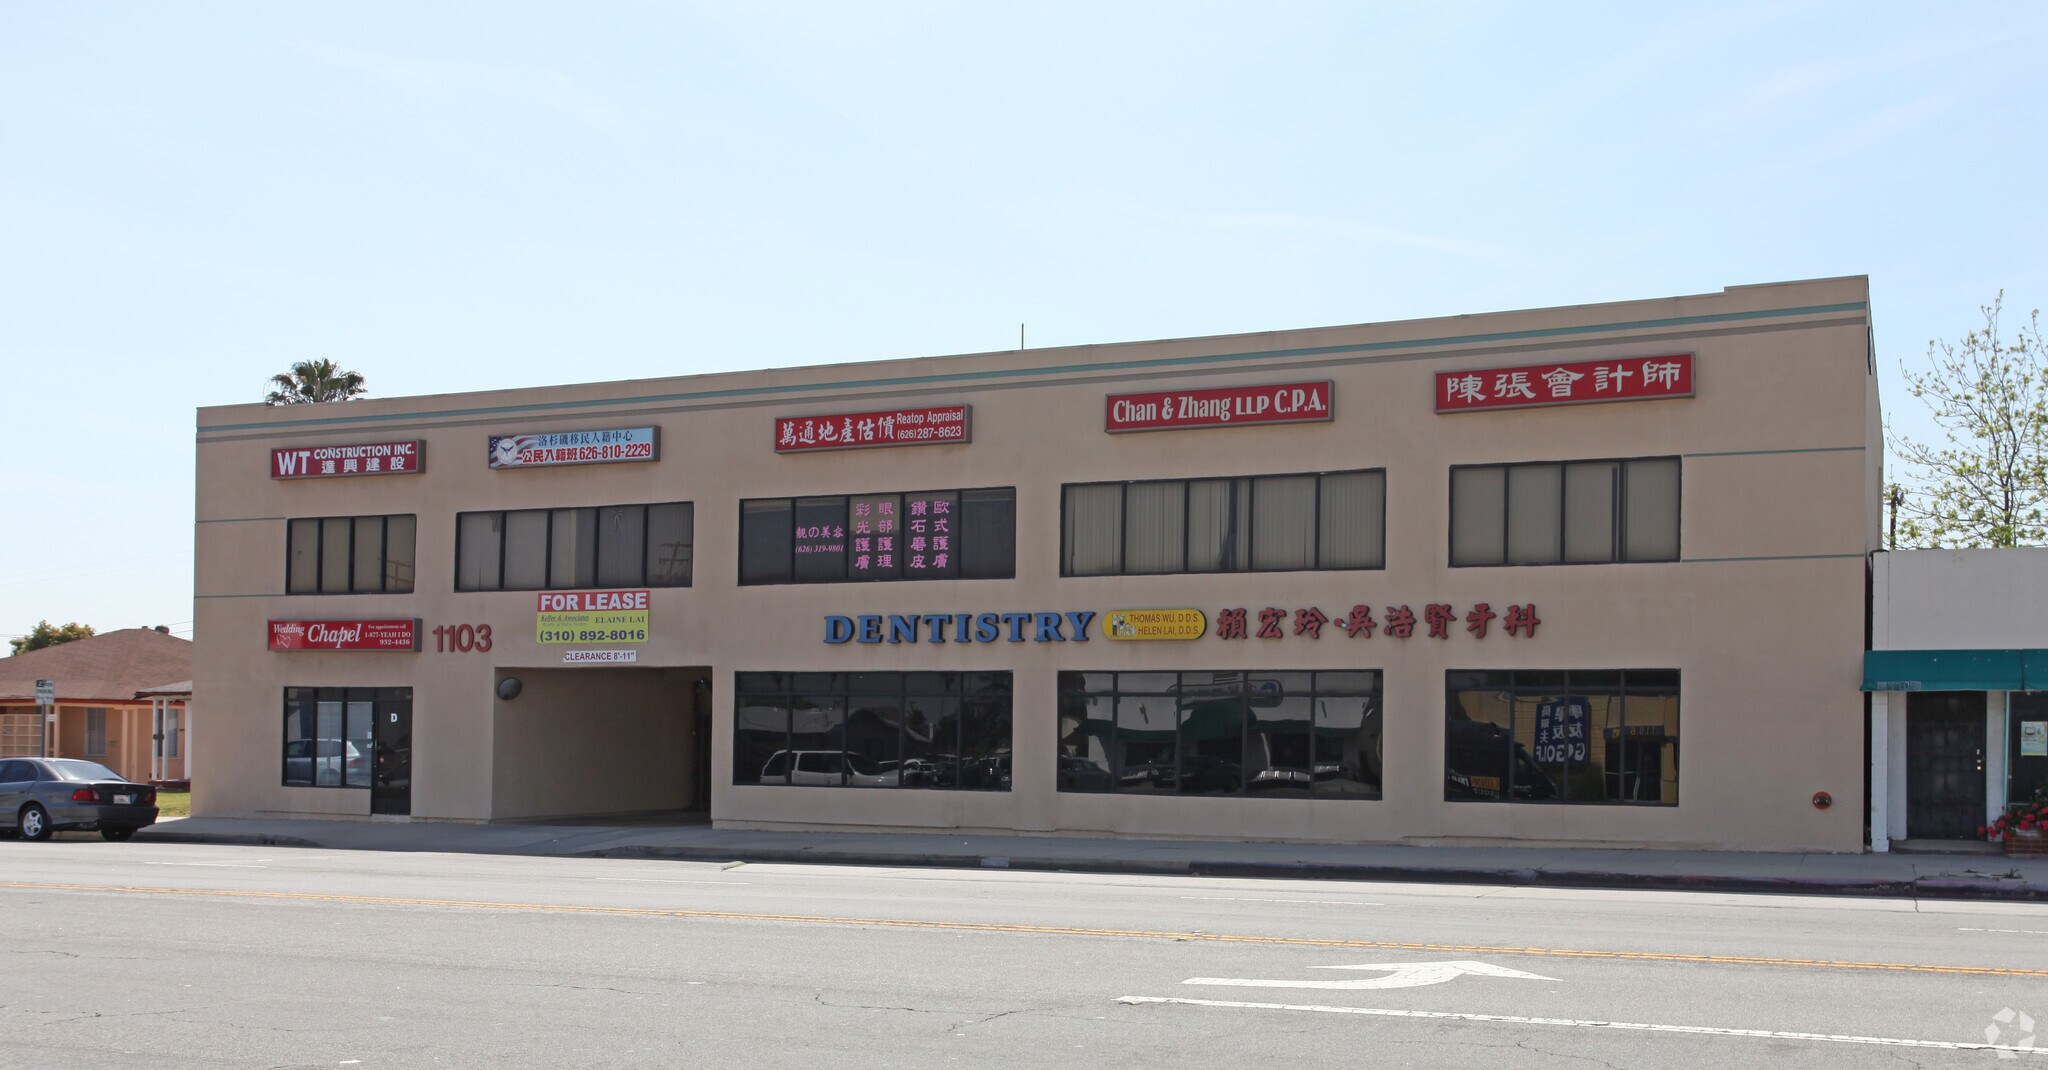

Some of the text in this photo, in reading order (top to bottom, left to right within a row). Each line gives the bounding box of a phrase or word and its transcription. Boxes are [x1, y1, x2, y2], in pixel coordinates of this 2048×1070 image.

[1447, 361, 1682, 403] 陳張會計師
[1113, 388, 1326, 423] Chan & Zhang LLP C.P.A.
[896, 409, 964, 427] Reatop Appraisal
[779, 416, 895, 446] 萬通地產估價
[277, 444, 415, 475] WT CONSTRUCTION INC.
[579, 443, 651, 460] 626-810-2229
[321, 457, 405, 474] 達興建設
[855, 503, 871, 570] 彩光護膚
[877, 503, 893, 568] 眼部護理
[932, 501, 950, 568] 歐式護膚
[795, 545, 844, 553] (626) 319-9801
[541, 592, 647, 610] FOR LEASE
[595, 616, 627, 624] ELAINE
[823, 611, 1096, 644] DENTISTRY
[1129, 614, 1160, 623] THOMAS
[273, 623, 305, 636] Wedding
[307, 623, 363, 649] Chapel
[432, 624, 493, 653] 1103
[540, 629, 645, 642] (310) 892-8016
[1138, 626, 1162, 635] HELEN
[391, 713, 398, 722] D
